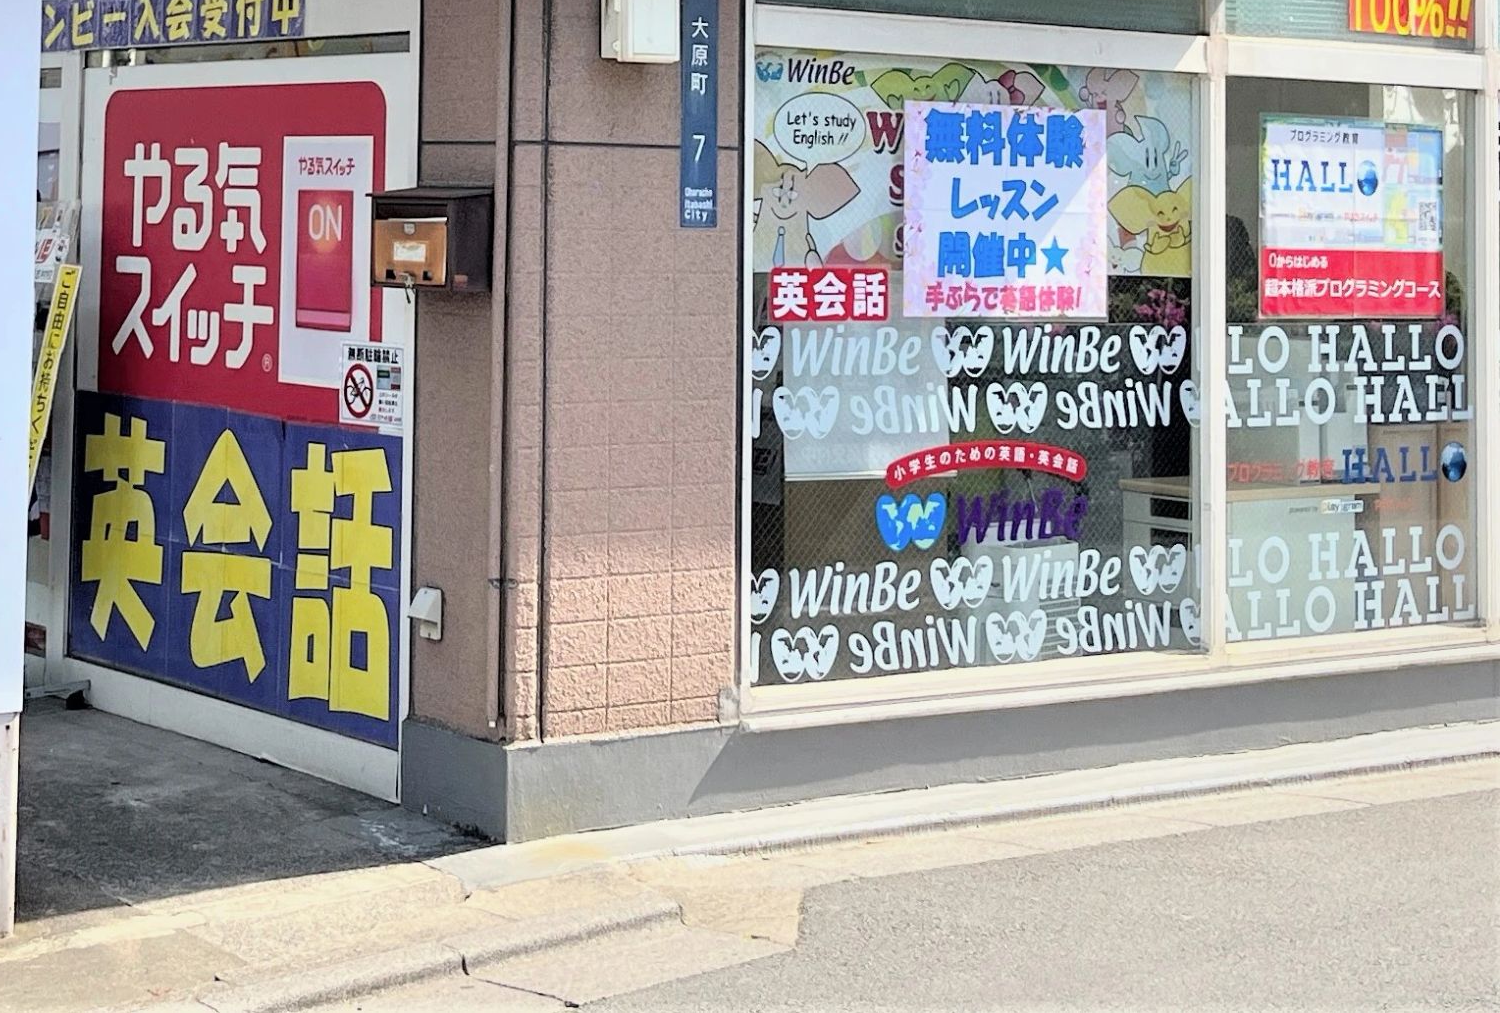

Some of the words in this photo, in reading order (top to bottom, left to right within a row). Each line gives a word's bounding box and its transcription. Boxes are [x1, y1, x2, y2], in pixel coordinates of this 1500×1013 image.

[691, 17, 710, 96] 大原町
[788, 58, 855, 85] WinBe
[786, 112, 819, 126] Let's
[824, 113, 857, 132] study
[793, 130, 835, 149] English
[924, 108, 1085, 168] 無料体験
[1290, 129, 1359, 145] プログラミング教育
[298, 156, 356, 176] やる気スイッチ
[693, 134, 706, 164] 7
[123, 141, 268, 254] やる気
[684, 209, 708, 222] City
[950, 177, 1060, 221] レッスン
[308, 204, 342, 241] ON
[772, 273, 887, 320] 英会話
[792, 324, 921, 377] WinBe
[1002, 323, 1121, 375] WinBe
[1308, 324, 1465, 373] HALLO
[894, 446, 1079, 482] 小学生のための英語・英会話
[956, 487, 1088, 545] WinBe
[81, 412, 393, 721] 英会話
[1308, 524, 1466, 580] HALLO
[789, 560, 921, 619] WinBe
[1001, 549, 1122, 603] WinBe
